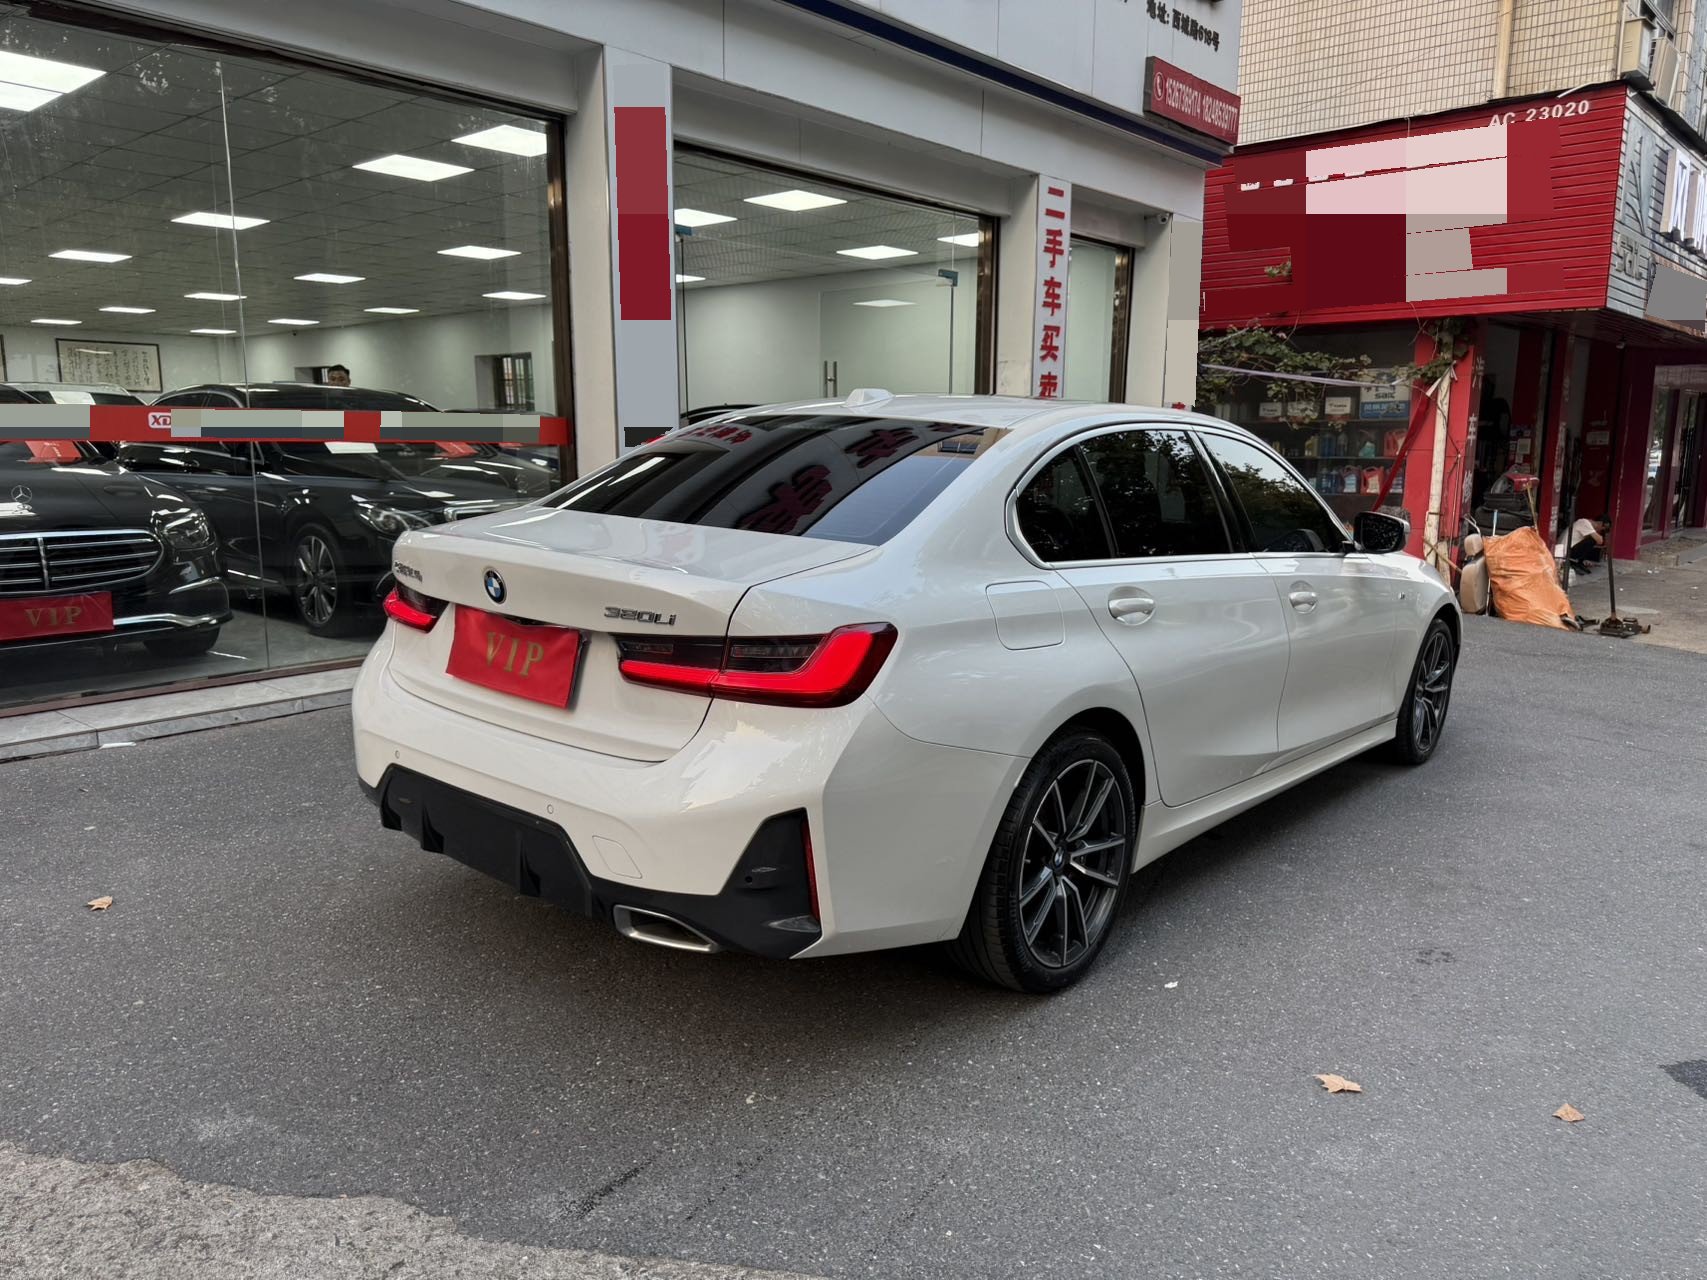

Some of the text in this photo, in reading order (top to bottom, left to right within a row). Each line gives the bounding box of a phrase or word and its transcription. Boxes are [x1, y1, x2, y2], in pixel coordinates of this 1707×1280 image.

[1525, 100, 1590, 122] 23020
[25, 606, 81, 628] VIP
[604, 606, 677, 626] 320Li
[486, 631, 544, 679] VIP
